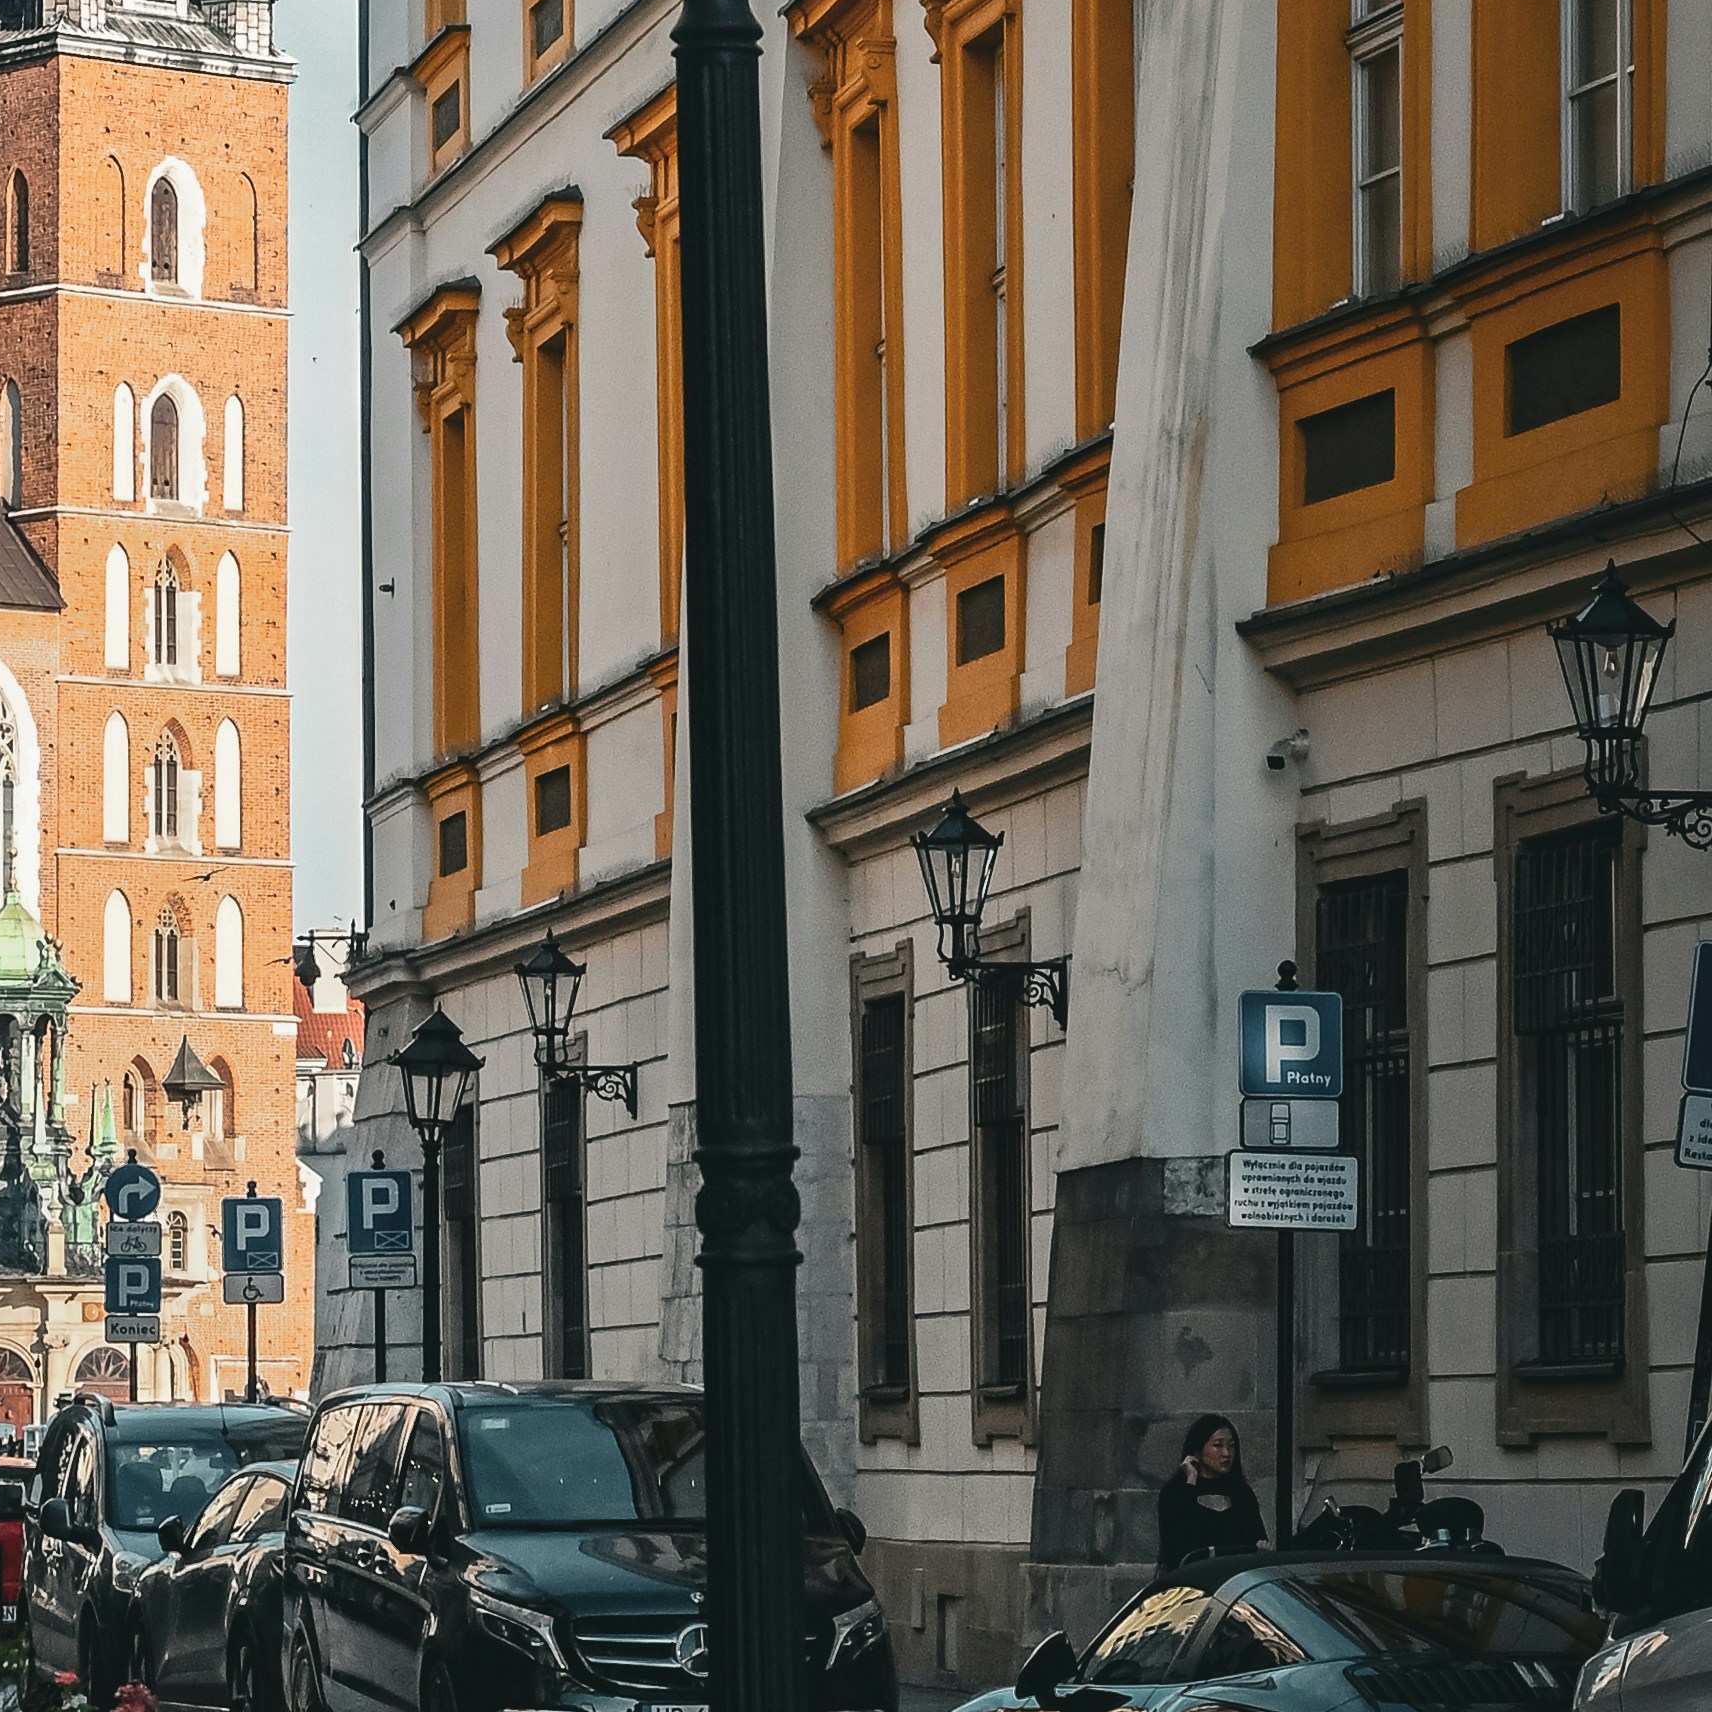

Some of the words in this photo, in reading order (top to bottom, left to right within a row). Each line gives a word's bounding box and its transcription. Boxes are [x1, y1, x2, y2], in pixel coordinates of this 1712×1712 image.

[1265, 1004, 1320, 1084] P
[1287, 1071, 1331, 1088] Płatny
[1288, 1160, 1302, 1171] dla
[1303, 1175, 1315, 1184] do
[362, 1178, 399, 1230] P
[1234, 1198, 1259, 1207] ruchu
[236, 1204, 270, 1251] P
[119, 1264, 150, 1307] P
[110, 1322, 156, 1335] Koniec
